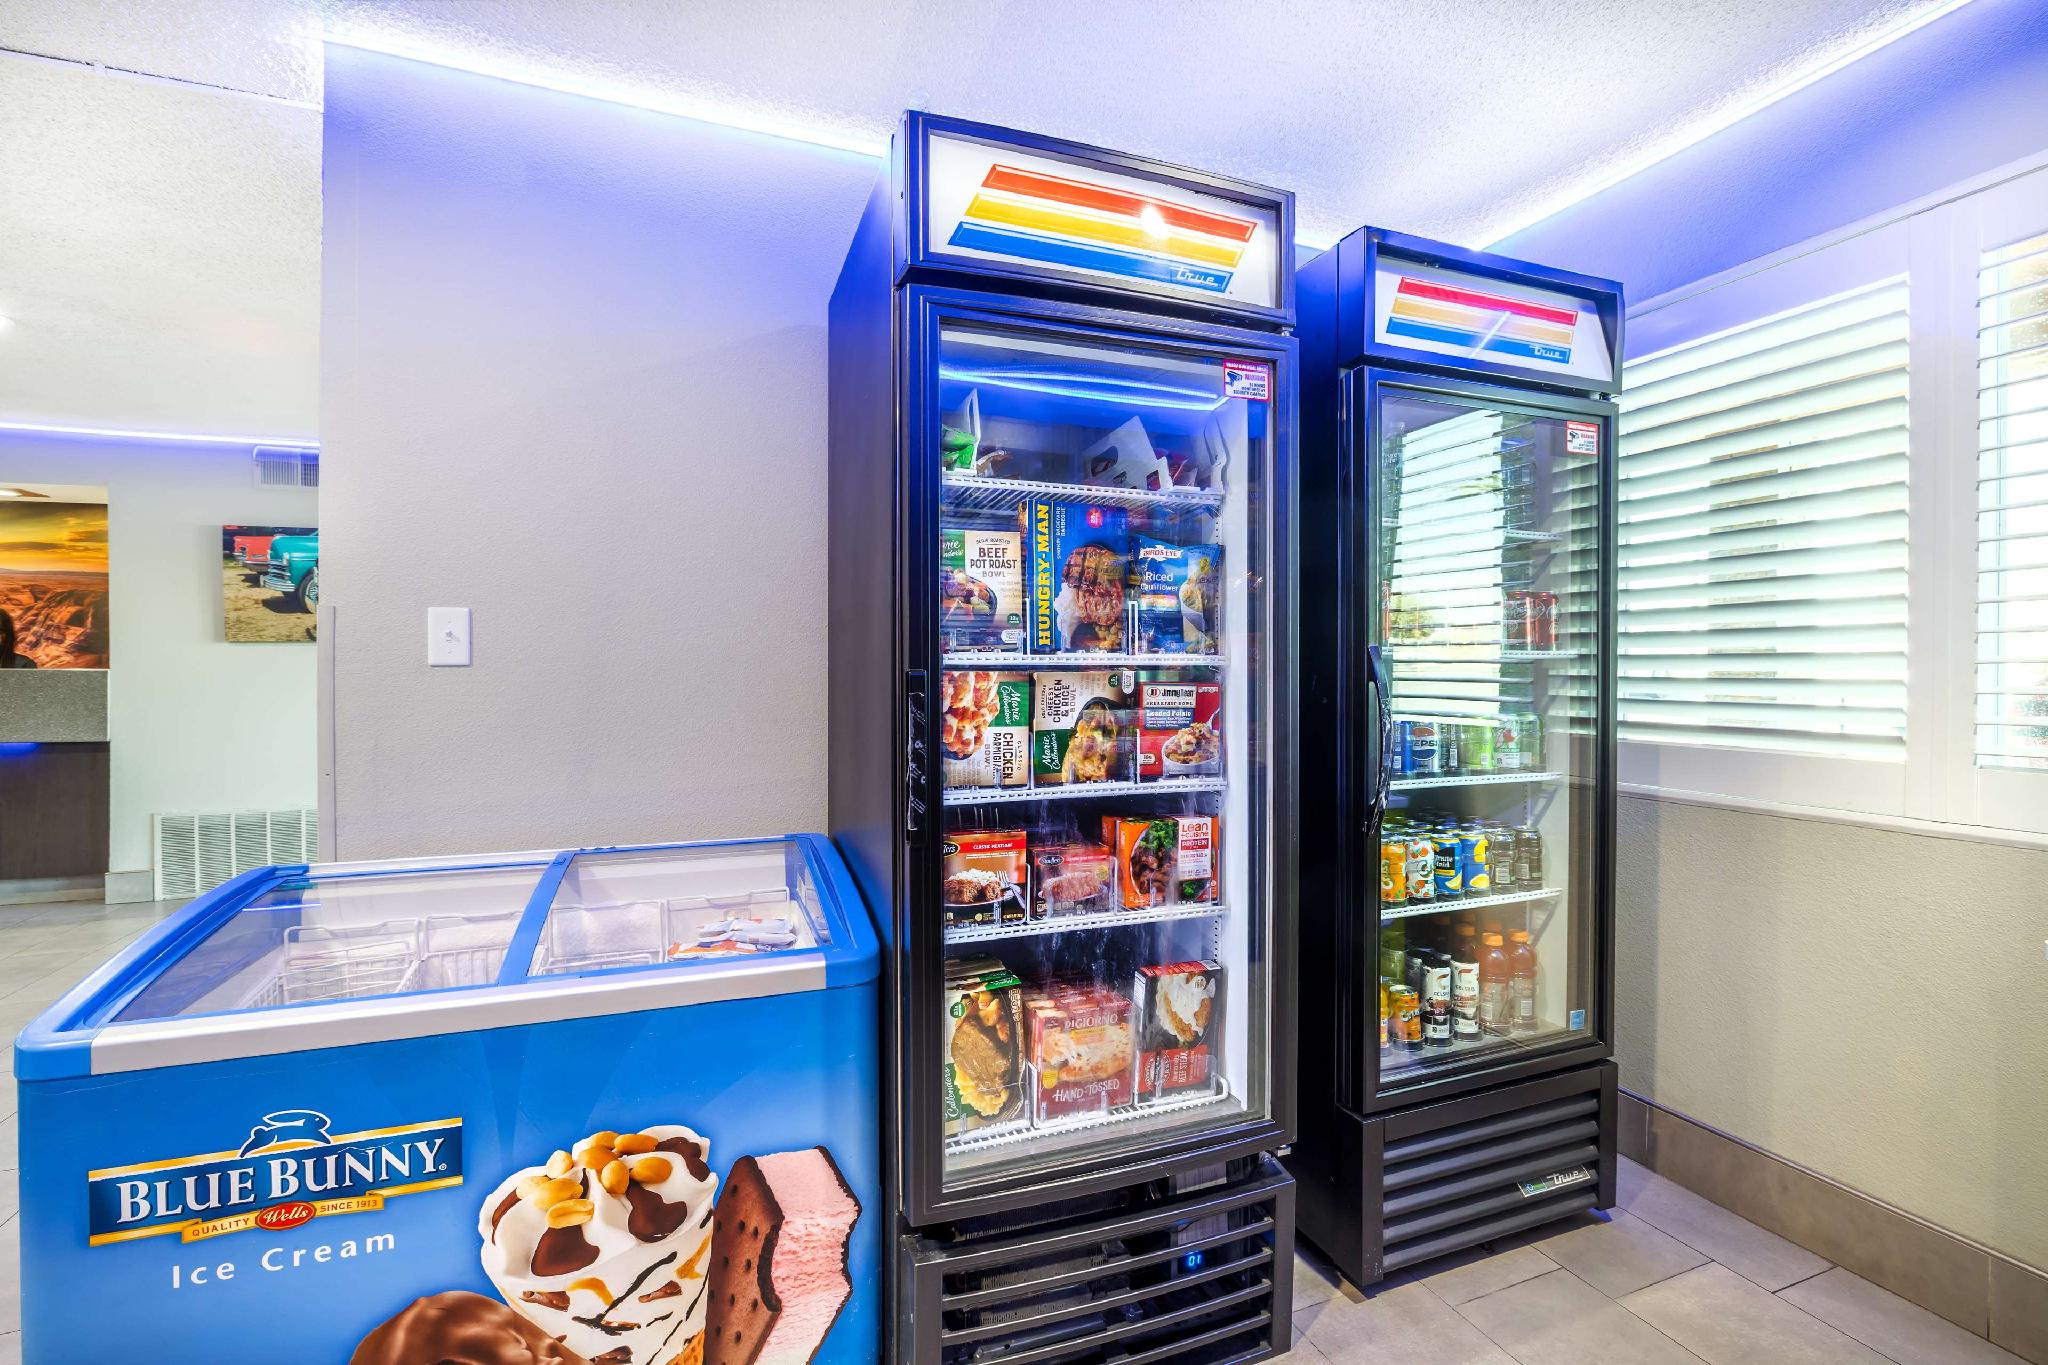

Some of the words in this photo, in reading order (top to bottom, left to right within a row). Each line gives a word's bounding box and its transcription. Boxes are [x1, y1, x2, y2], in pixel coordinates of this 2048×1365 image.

[1169, 266, 1219, 287] true
[978, 547, 1008, 558] BEEF
[970, 559, 988, 569] POT
[989, 559, 1018, 569] ROAST
[1037, 504, 1051, 646] HUNGRY-MAN
[1145, 571, 1174, 582] Riced
[1140, 583, 1179, 593] Cauliflower
[1053, 679, 1062, 723] CHICKEN
[1062, 685, 1070, 707] RICE
[1042, 734, 1052, 769] Marie
[1413, 739, 1438, 747] EPSI
[1002, 732, 1014, 780] CHICKEN
[1181, 822, 1209, 833] Lean
[1181, 839, 1208, 847] PROTEIN
[1064, 1014, 1118, 1029] DIGIORNO
[1052, 1078, 1120, 1102] HAND-TOSSED
[115, 1168, 256, 1225] BLUE
[267, 1136, 447, 1201] BUNNY
[191, 1216, 251, 1237] QUALITY
[262, 1204, 309, 1228] Wells
[319, 1201, 353, 1214] SINCE
[356, 1199, 378, 1210] 1913
[172, 1263, 236, 1289] Ice
[260, 1233, 396, 1273] Cream
